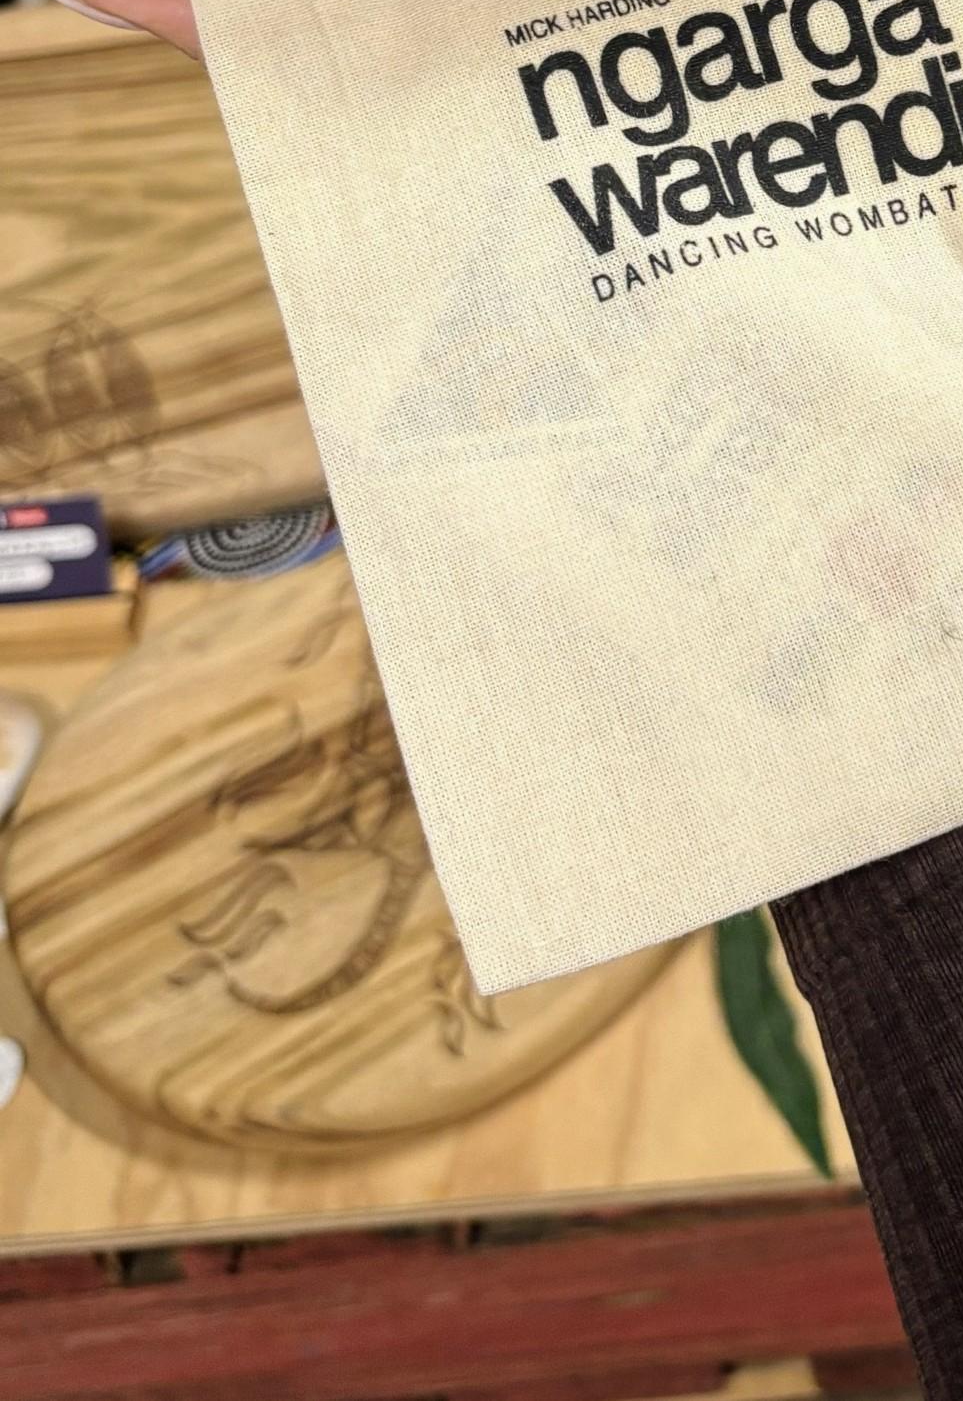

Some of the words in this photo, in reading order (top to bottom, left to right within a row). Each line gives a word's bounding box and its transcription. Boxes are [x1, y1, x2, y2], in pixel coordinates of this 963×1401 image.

[504, 14, 563, 47] MICK
[591, 226, 779, 302] DANCING
[795, 184, 961, 243] WOMBAT
